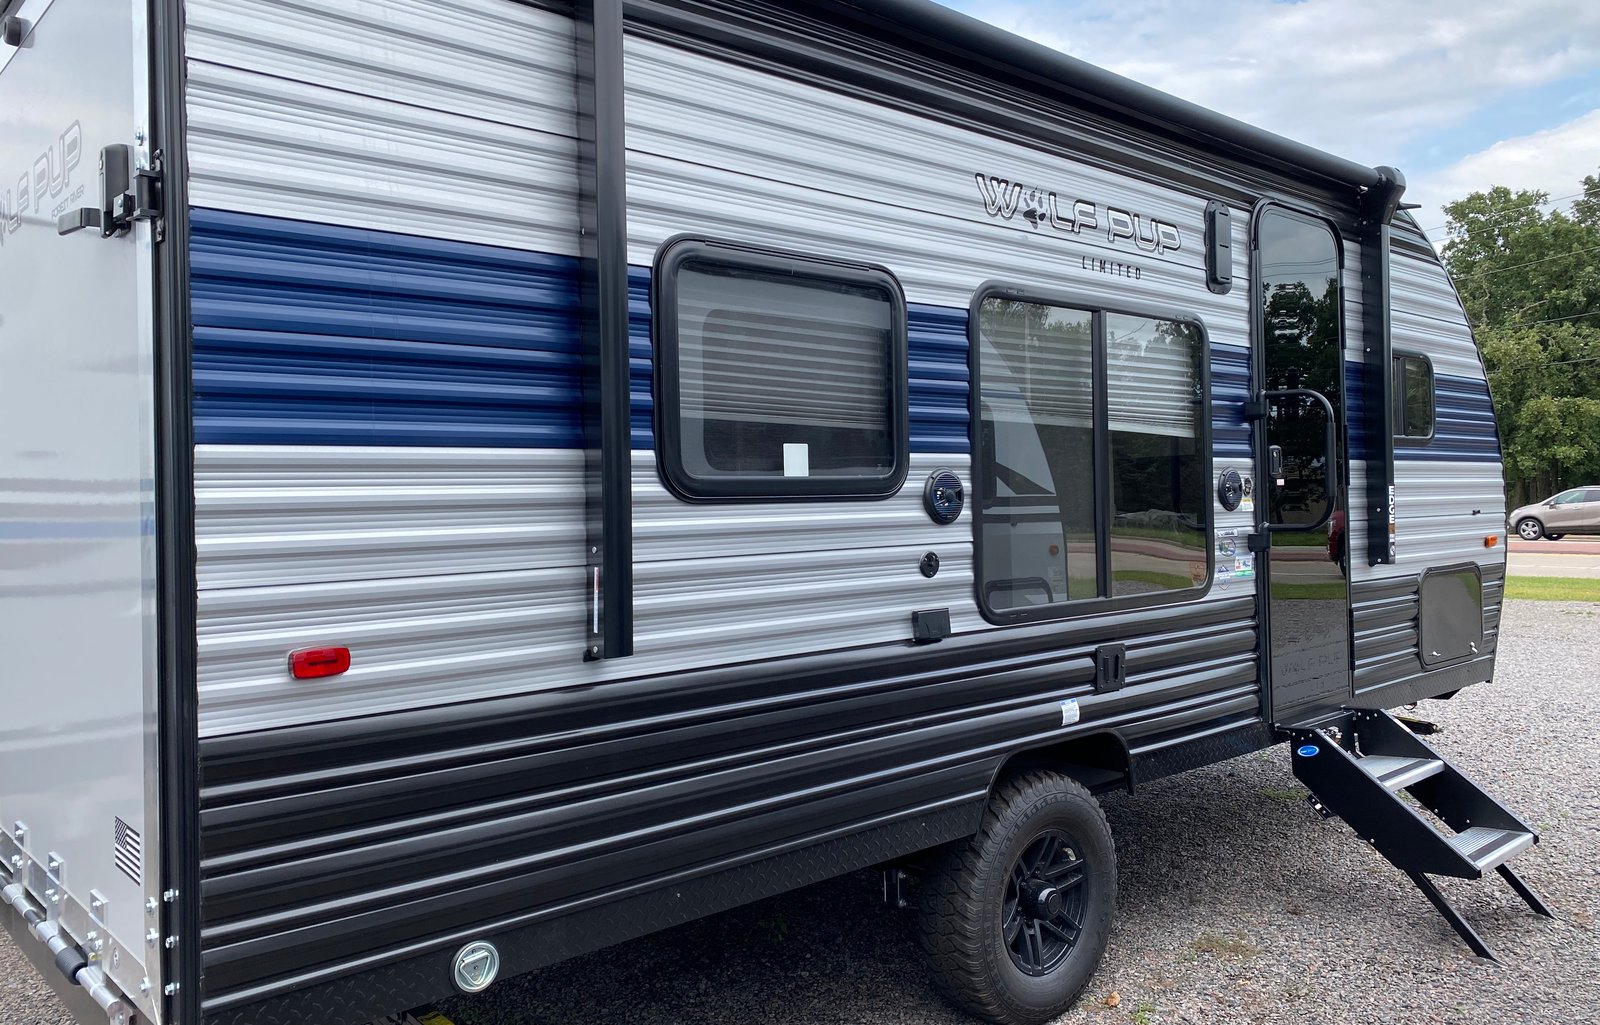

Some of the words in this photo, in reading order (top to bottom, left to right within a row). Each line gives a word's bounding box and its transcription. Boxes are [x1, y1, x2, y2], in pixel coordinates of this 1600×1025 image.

[33, 120, 82, 213] PUP
[1106, 206, 1181, 254] PUP
[1082, 255, 1141, 280] LIMITED
